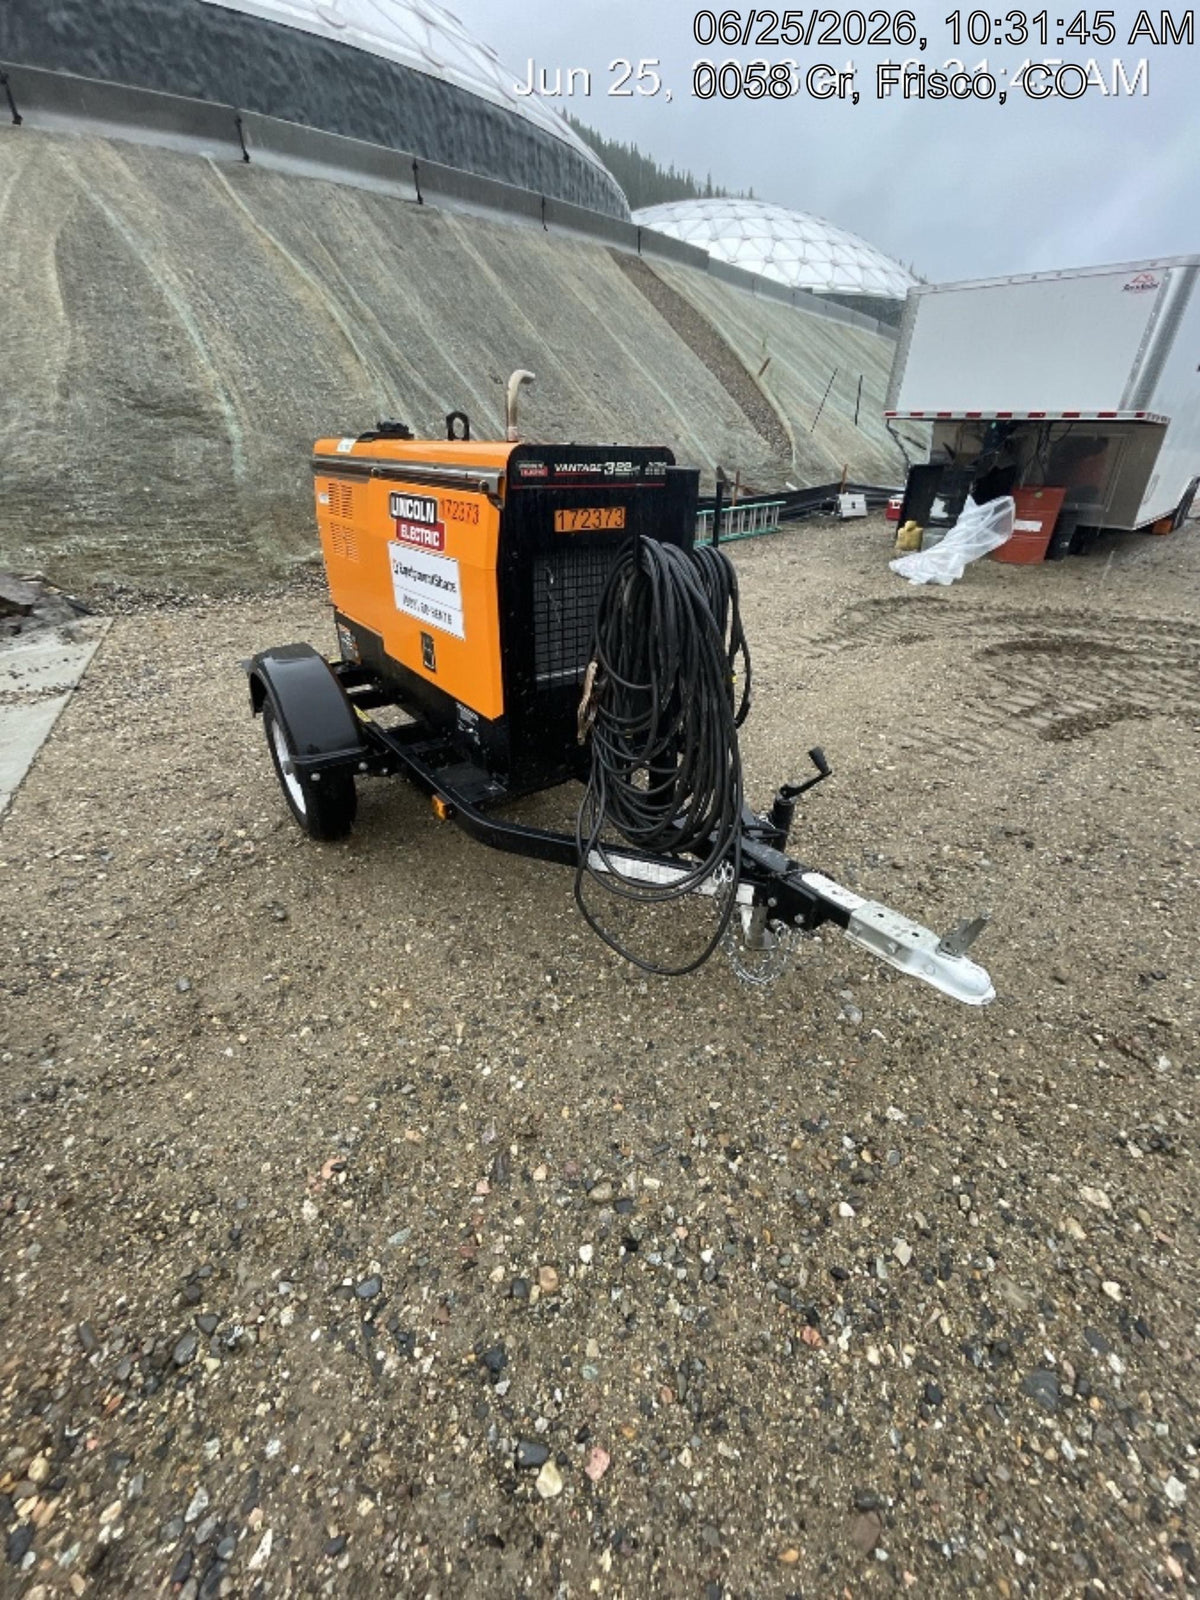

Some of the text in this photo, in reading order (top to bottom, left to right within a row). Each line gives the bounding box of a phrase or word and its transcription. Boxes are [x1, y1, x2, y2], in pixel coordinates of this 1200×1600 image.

[554, 463, 602, 473] VANTAGE
[391, 496, 436, 523] LINCOLN
[440, 498, 480, 525] 172373
[556, 508, 625, 531] 172373
[400, 524, 441, 547] ELECTRIC
